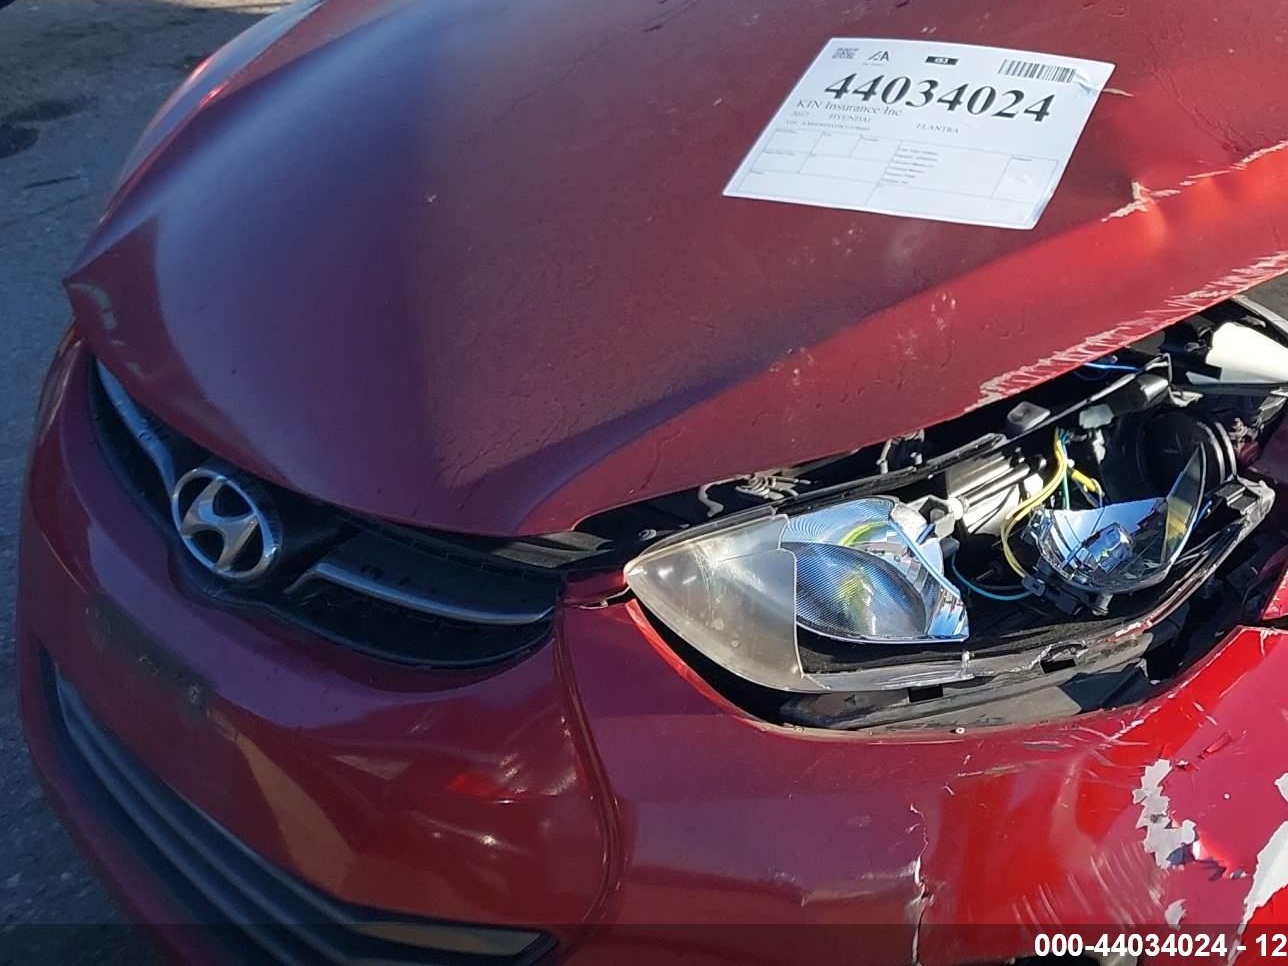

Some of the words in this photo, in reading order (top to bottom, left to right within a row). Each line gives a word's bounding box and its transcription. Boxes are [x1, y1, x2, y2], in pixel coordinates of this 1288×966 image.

[796, 99, 822, 110] KIN
[825, 101, 881, 115] Insurance
[883, 105, 902, 117] Inc
[824, 72, 1056, 123] 44034024
